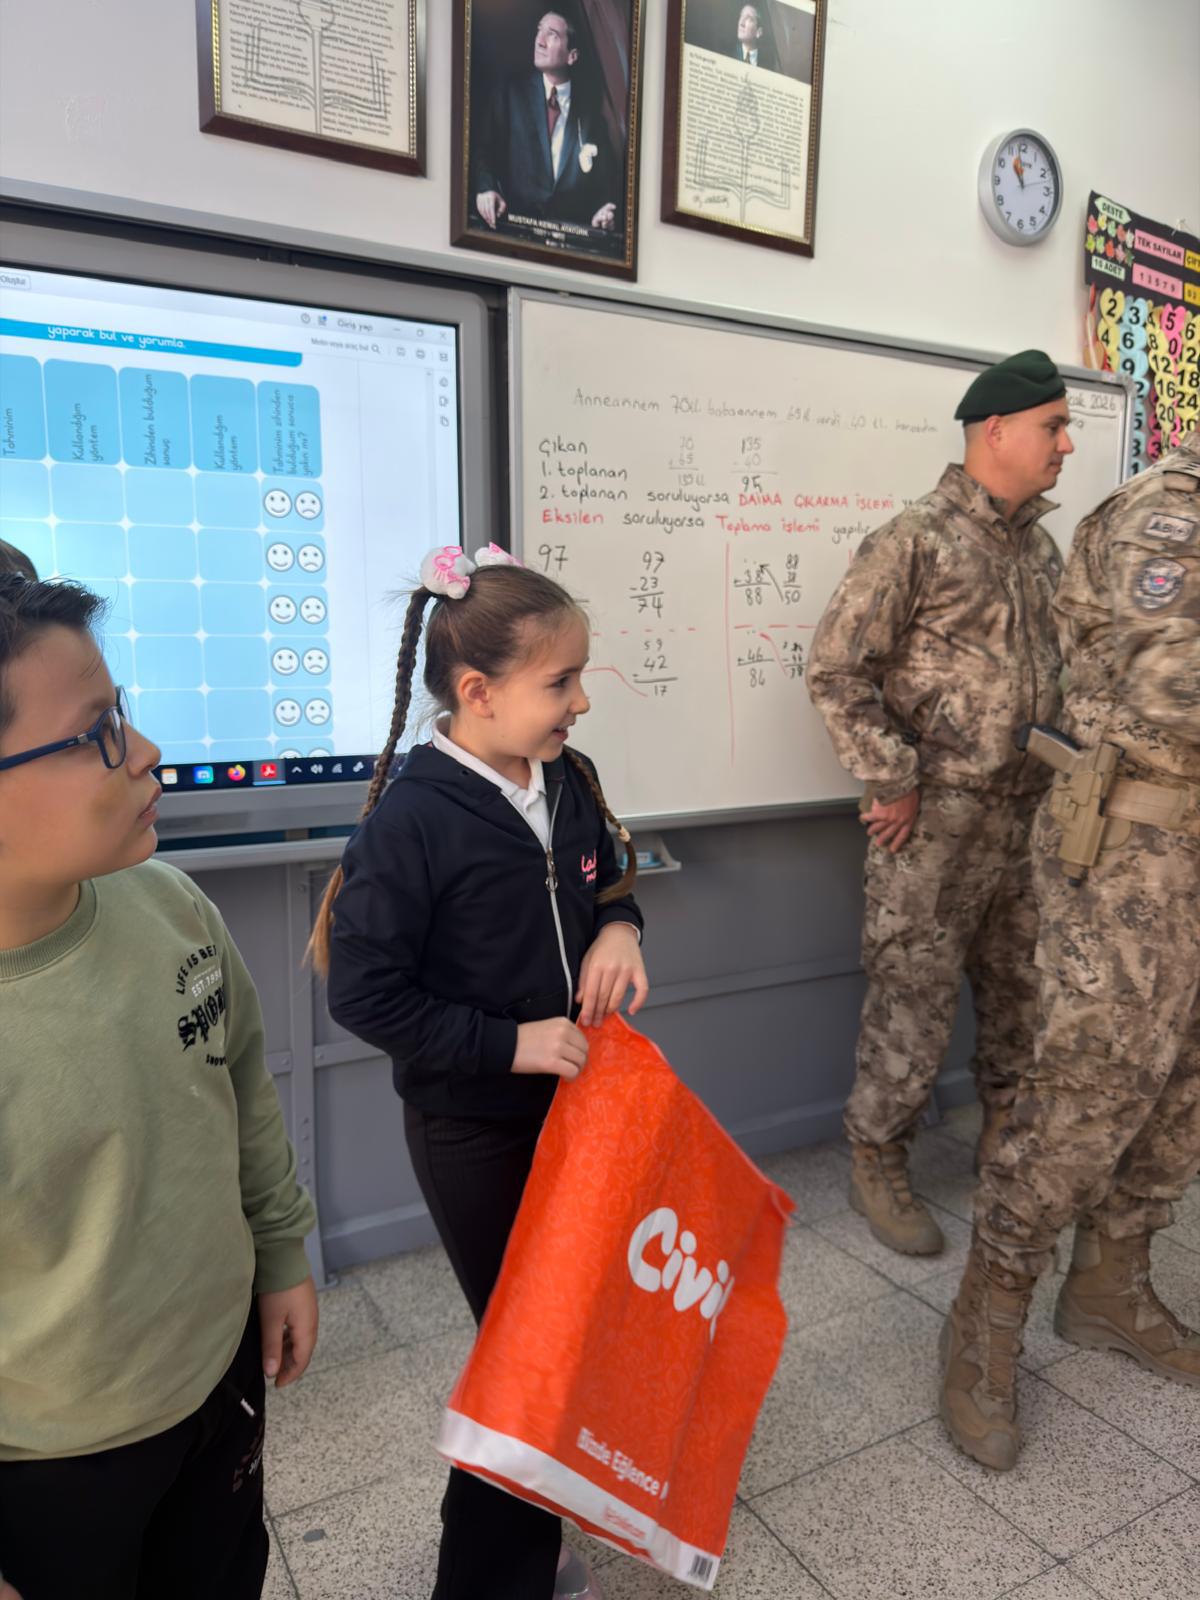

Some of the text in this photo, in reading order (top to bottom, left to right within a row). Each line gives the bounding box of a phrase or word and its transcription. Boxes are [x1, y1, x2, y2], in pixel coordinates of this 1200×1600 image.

[1039, 168, 1047, 179] 2
[997, 194, 1005, 206] 8
[1042, 186, 1051, 197] 3
[1101, 202, 1124, 219] DESTE
[1016, 219, 1025, 230] 6
[1029, 216, 1037, 227] 5
[1137, 236, 1182, 258] TEK SAYILAR
[1104, 260, 1123, 276] ADET
[1106, 298, 1117, 317] 2
[1129, 306, 1140, 325] 3
[1165, 312, 1176, 331] 5
[1185, 322, 1196, 340] 6
[47, 325, 186, 350] yaparak bul ve yorumla.
[1101, 332, 1110, 346] 4
[1122, 332, 1135, 350] 6
[1149, 333, 1159, 350] 8
[1122, 358, 1136, 375] 9
[1151, 354, 1172, 374] 12
[1156, 379, 1176, 398] 16
[1175, 370, 1200, 389] 18
[573, 388, 661, 411] Anneannem
[1089, 393, 1117, 412] 2026
[1176, 391, 1199, 411] 24
[1159, 403, 1175, 422] 20
[3, 408, 16, 456] Tahminim
[71, 402, 87, 461] Kullandığım
[87, 424, 104, 463] yöntem
[228, 434, 243, 471] yöntem
[538, 435, 588, 458] Çıkan
[541, 461, 629, 486] 1. toplanan
[539, 485, 555, 501] 2.
[561, 485, 629, 504] toplanan
[647, 488, 730, 512] soruluyorsa
[541, 507, 605, 526] Eksilen
[622, 509, 706, 535] soruluyorsa
[538, 544, 569, 572] 97
[642, 551, 665, 574] 97
[639, 576, 659, 592] 23
[744, 587, 763, 607] 88
[643, 654, 668, 672] 42
[653, 684, 668, 697] 17
[175, 965, 189, 996] LIFE
[186, 953, 199, 969] IS
